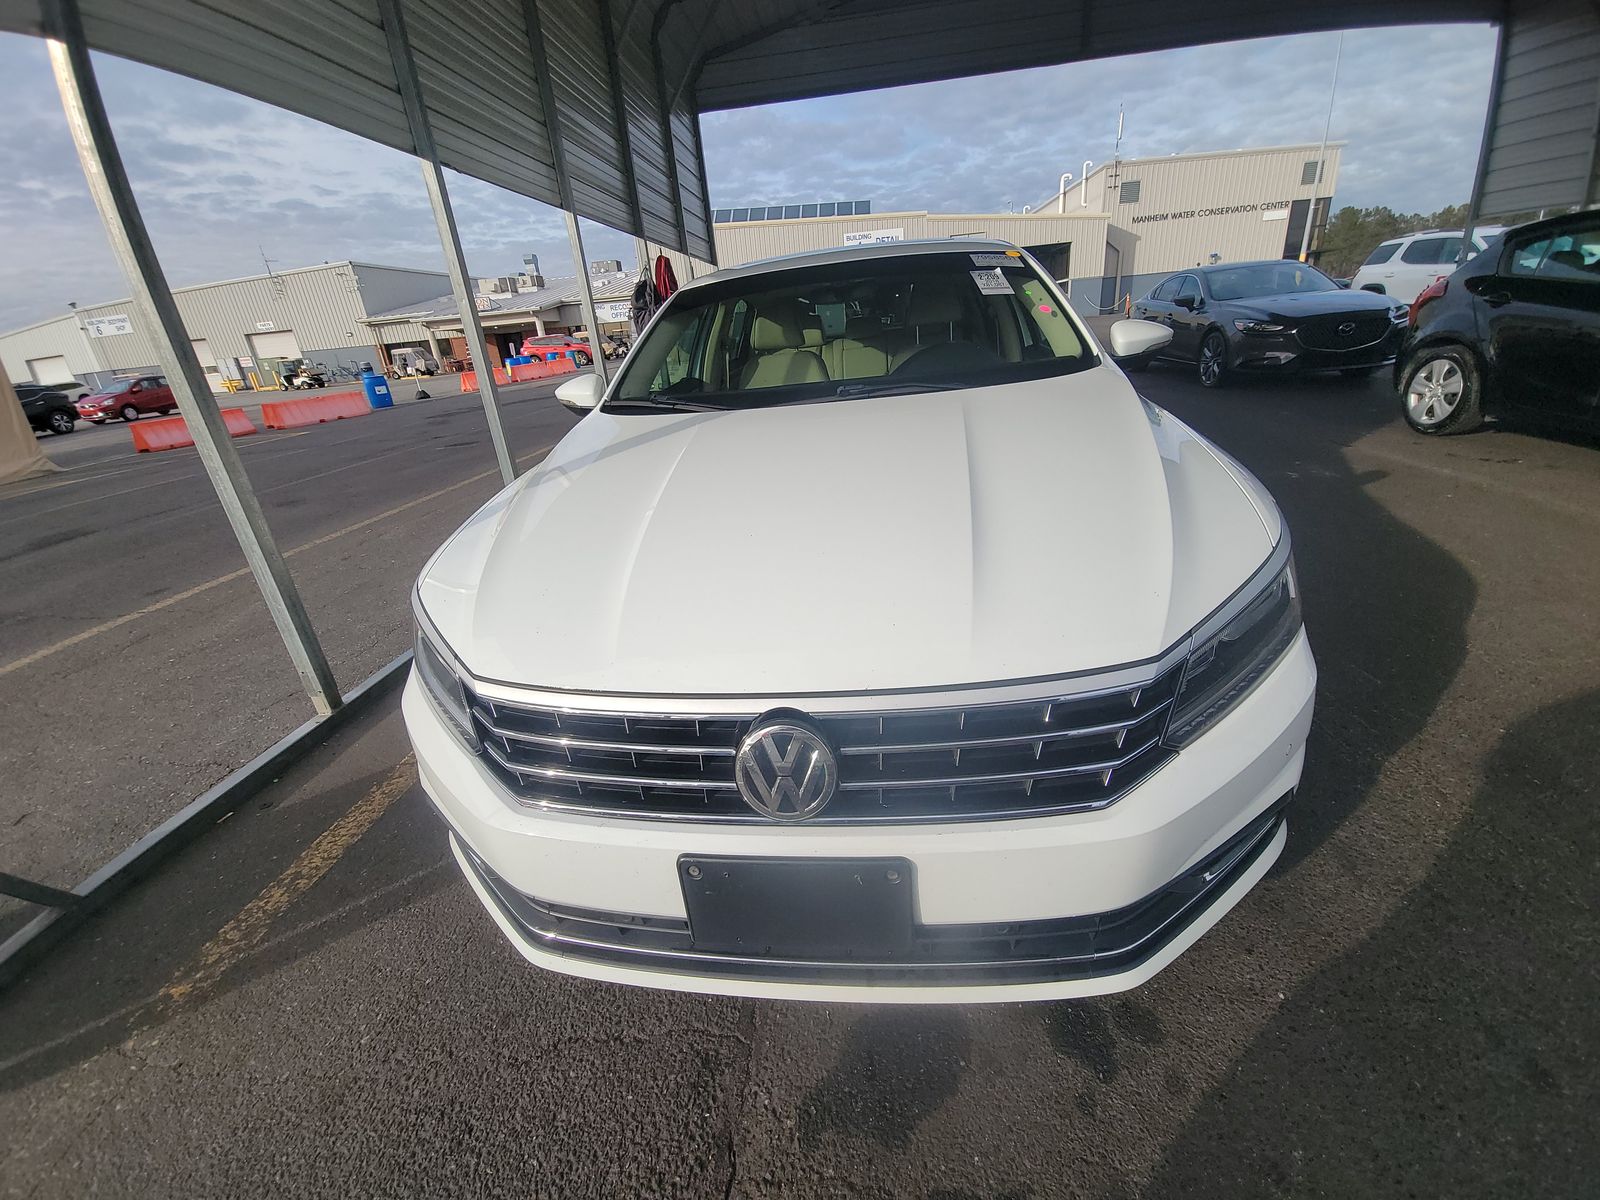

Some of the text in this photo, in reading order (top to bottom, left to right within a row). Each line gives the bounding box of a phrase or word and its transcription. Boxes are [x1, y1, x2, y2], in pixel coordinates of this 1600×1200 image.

[1132, 200, 1290, 225] MANHEIM WATER CONSERVATION CENTER
[846, 233, 872, 242] BUILDING
[611, 311, 630, 319] OFFIC
[96, 325, 103, 336] 6
[738, 727, 834, 819] VW
